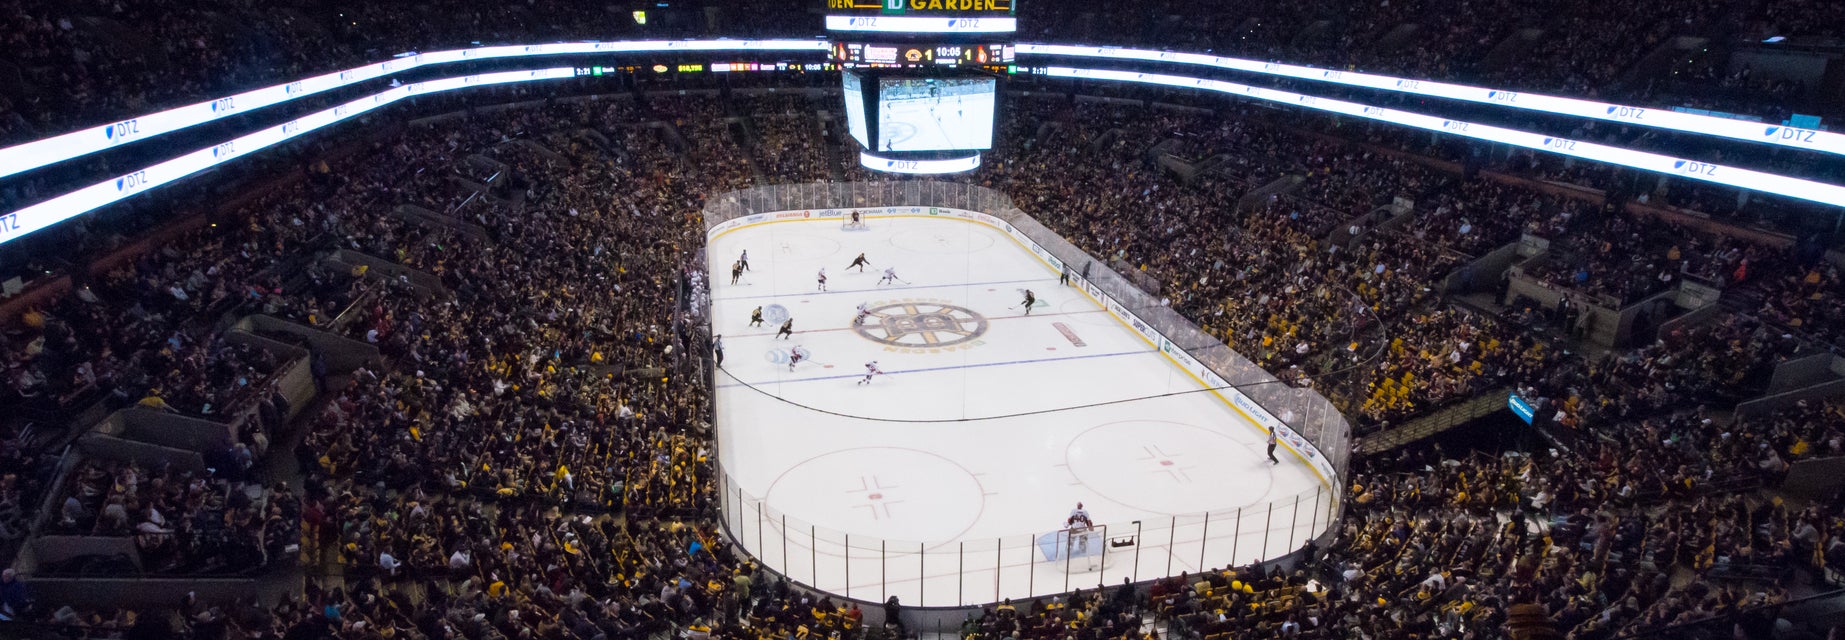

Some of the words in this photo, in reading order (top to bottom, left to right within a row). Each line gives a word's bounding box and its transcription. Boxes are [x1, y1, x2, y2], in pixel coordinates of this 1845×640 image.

[828, 0, 853, 8] DEN
[910, 0, 994, 10] GARDEN
[858, 18, 876, 27] DTZ
[960, 18, 979, 28] DTZ
[925, 49, 932, 60] 1
[936, 47, 961, 56] 10:05
[965, 49, 971, 60] 1
[576, 67, 590, 75] 2:21
[1032, 67, 1046, 75] 2:21
[1329, 71, 1342, 79] DTZ
[291, 81, 303, 93] DTZ
[1404, 80, 1419, 90] DTZ
[1305, 96, 1317, 104] DTZ
[1498, 91, 1517, 102] DTZ
[220, 97, 235, 111] DTZ
[1370, 106, 1384, 116] DTZ
[1620, 107, 1645, 119] DTZ
[117, 120, 139, 137] DTZ
[1451, 122, 1469, 132] DTZ
[1782, 128, 1816, 143] DTZ
[221, 142, 235, 156] DTZ
[1555, 139, 1576, 151] DTZ
[897, 161, 918, 170] DTZ
[1688, 162, 1717, 176] DTZ
[127, 171, 147, 188] DTZ
[0, 213, 20, 234] TZ
[1236, 396, 1250, 409] BUD
[1249, 406, 1267, 422] LIGHT
[1073, 514, 1085, 523] 40
